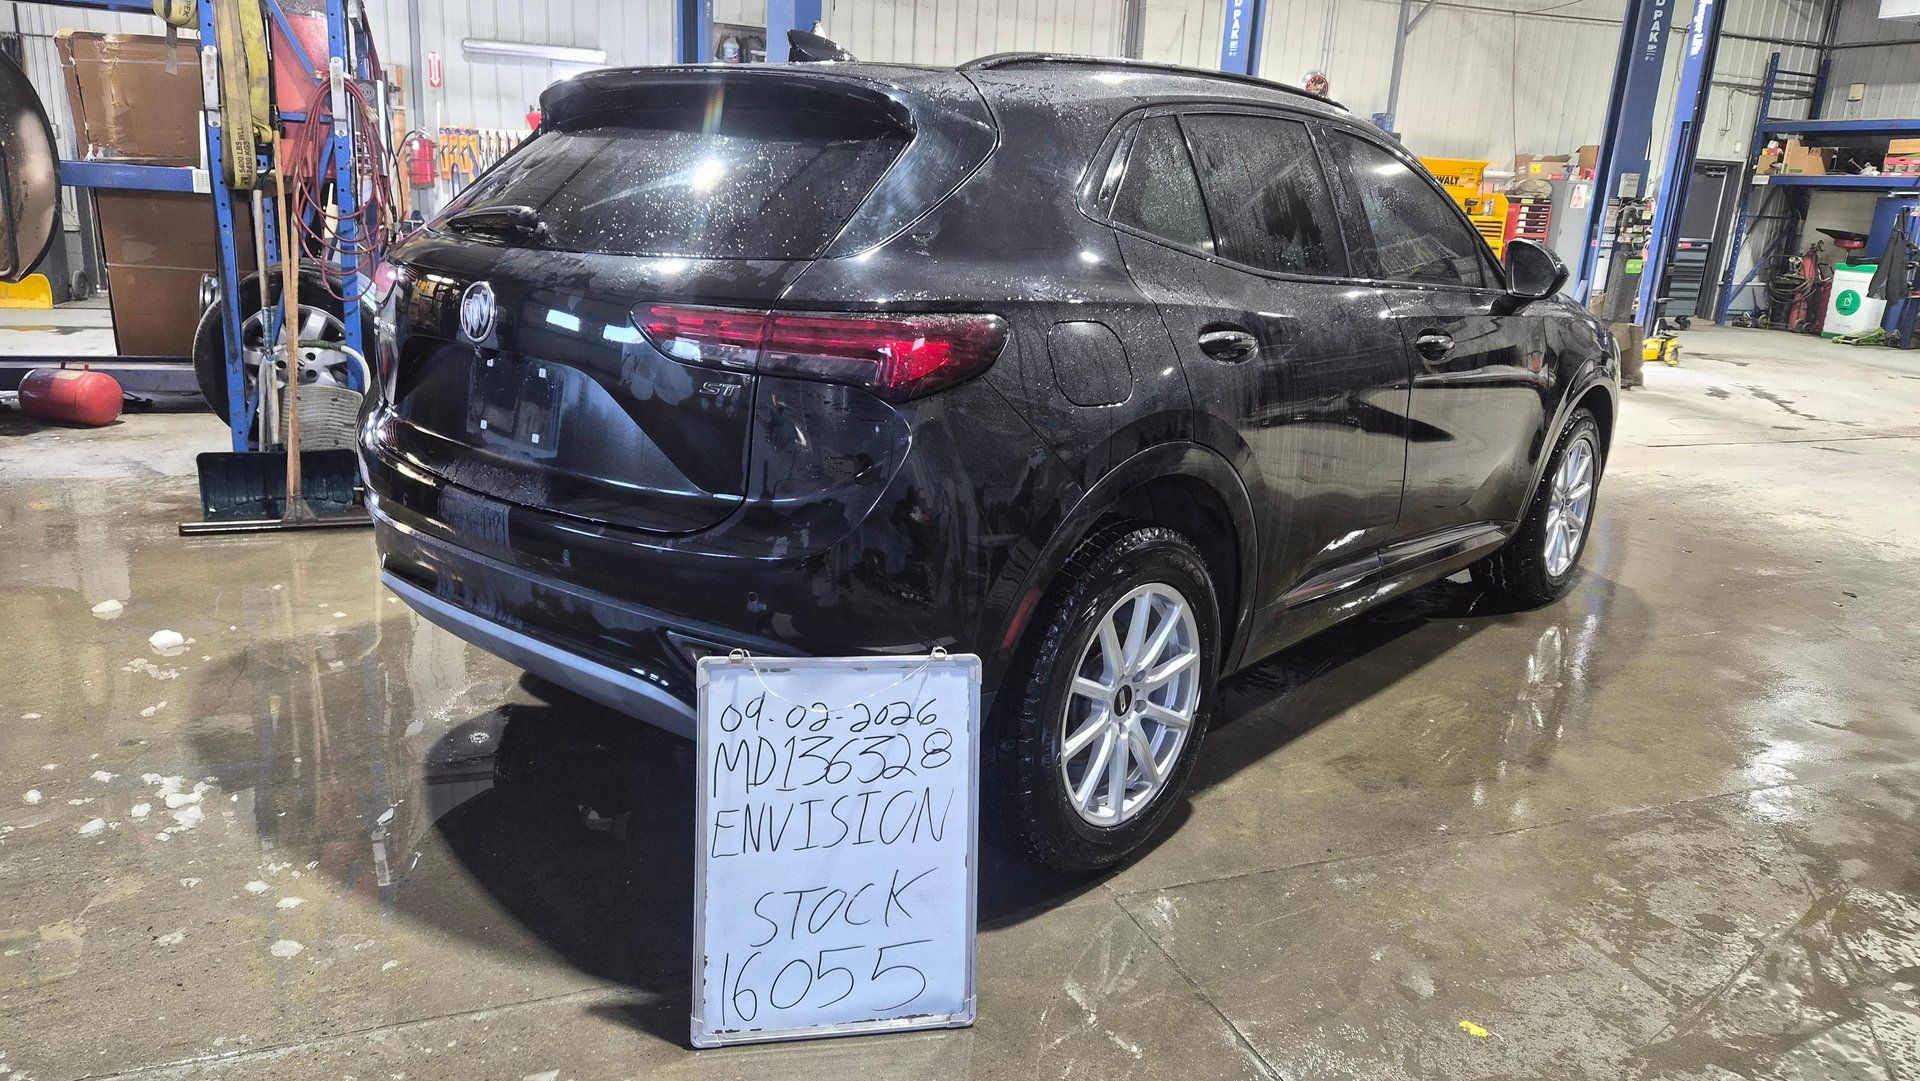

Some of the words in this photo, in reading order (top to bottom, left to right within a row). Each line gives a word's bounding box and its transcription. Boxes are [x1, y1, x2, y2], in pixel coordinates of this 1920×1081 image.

[236, 141, 244, 155] LBS
[243, 141, 252, 156] KGS
[699, 381, 741, 397] ST
[714, 727, 953, 798] MD136328
[711, 787, 955, 858] ENVISION
[750, 867, 939, 947] STOCK
[721, 939, 933, 1026] 16055
